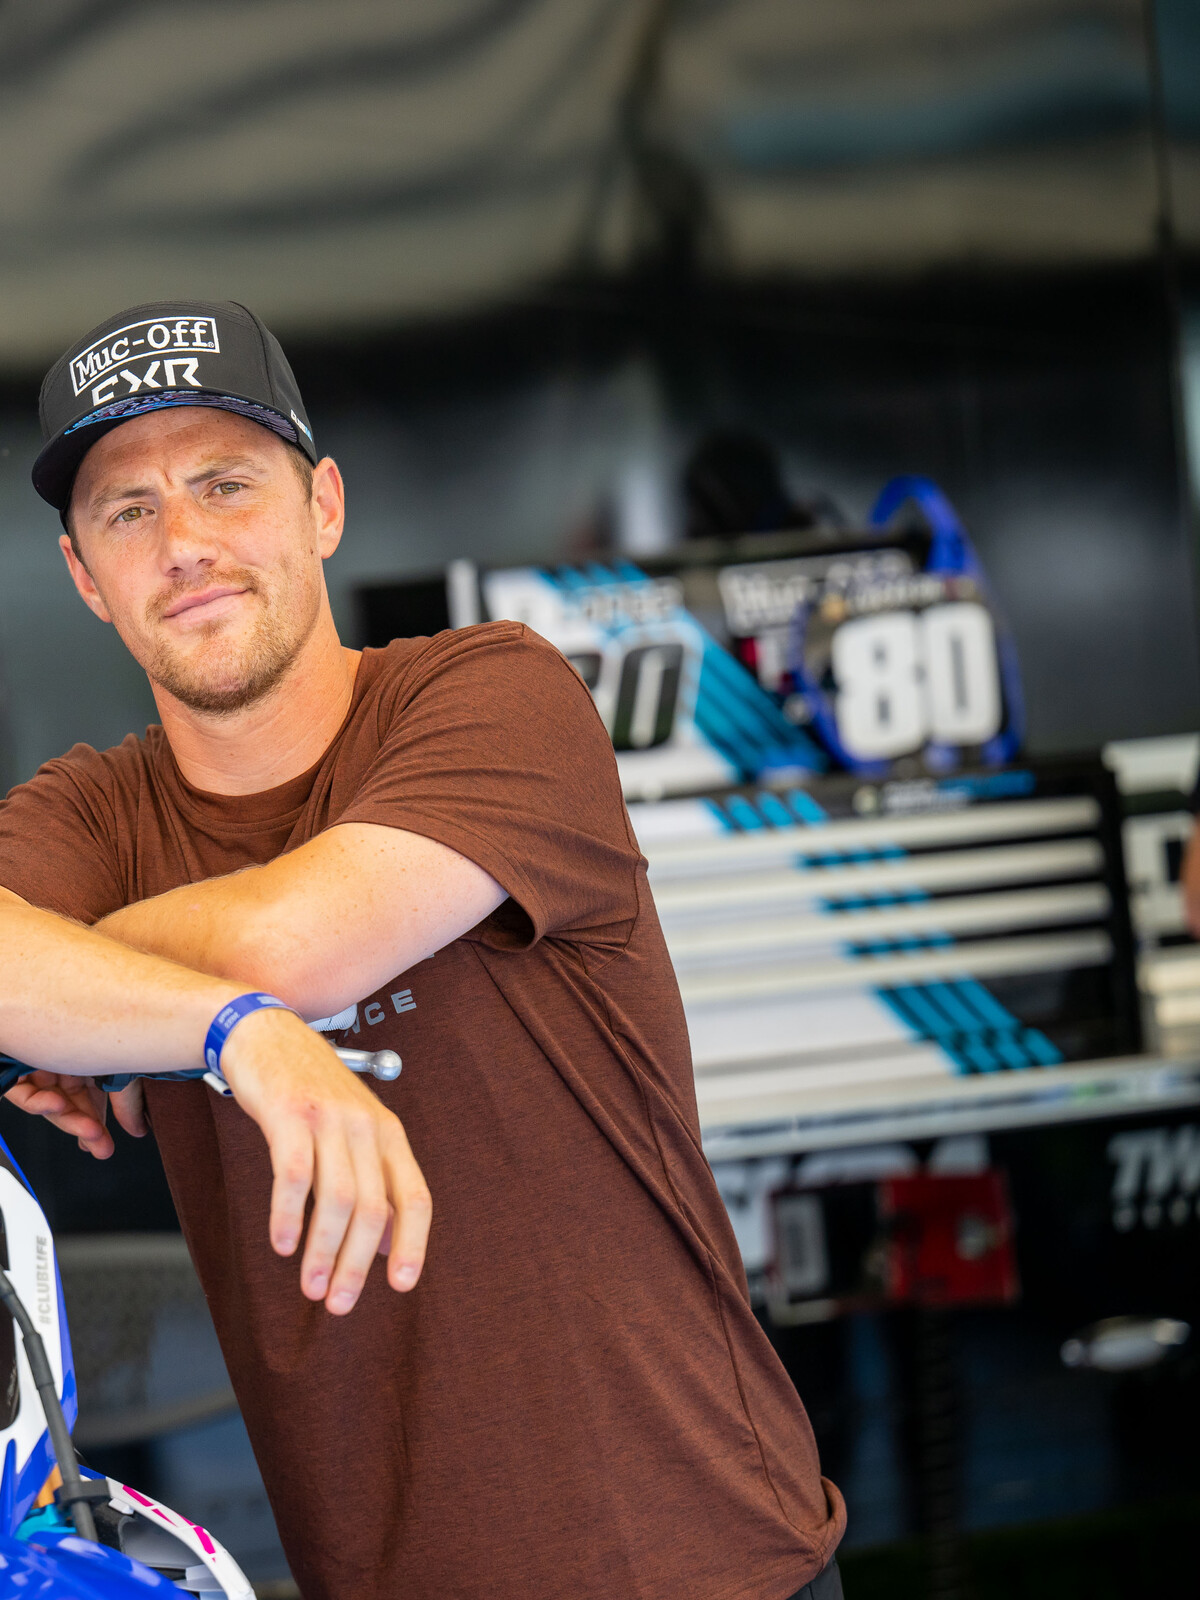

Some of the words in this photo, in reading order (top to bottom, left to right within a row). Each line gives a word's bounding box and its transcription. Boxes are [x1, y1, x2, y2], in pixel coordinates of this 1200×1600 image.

[74, 321, 212, 386] Muc-Off
[92, 357, 202, 406] FXR
[569, 644, 684, 752] 0
[832, 602, 1001, 760] 80
[36, 1235, 52, 1325] #CLUBLIFE
